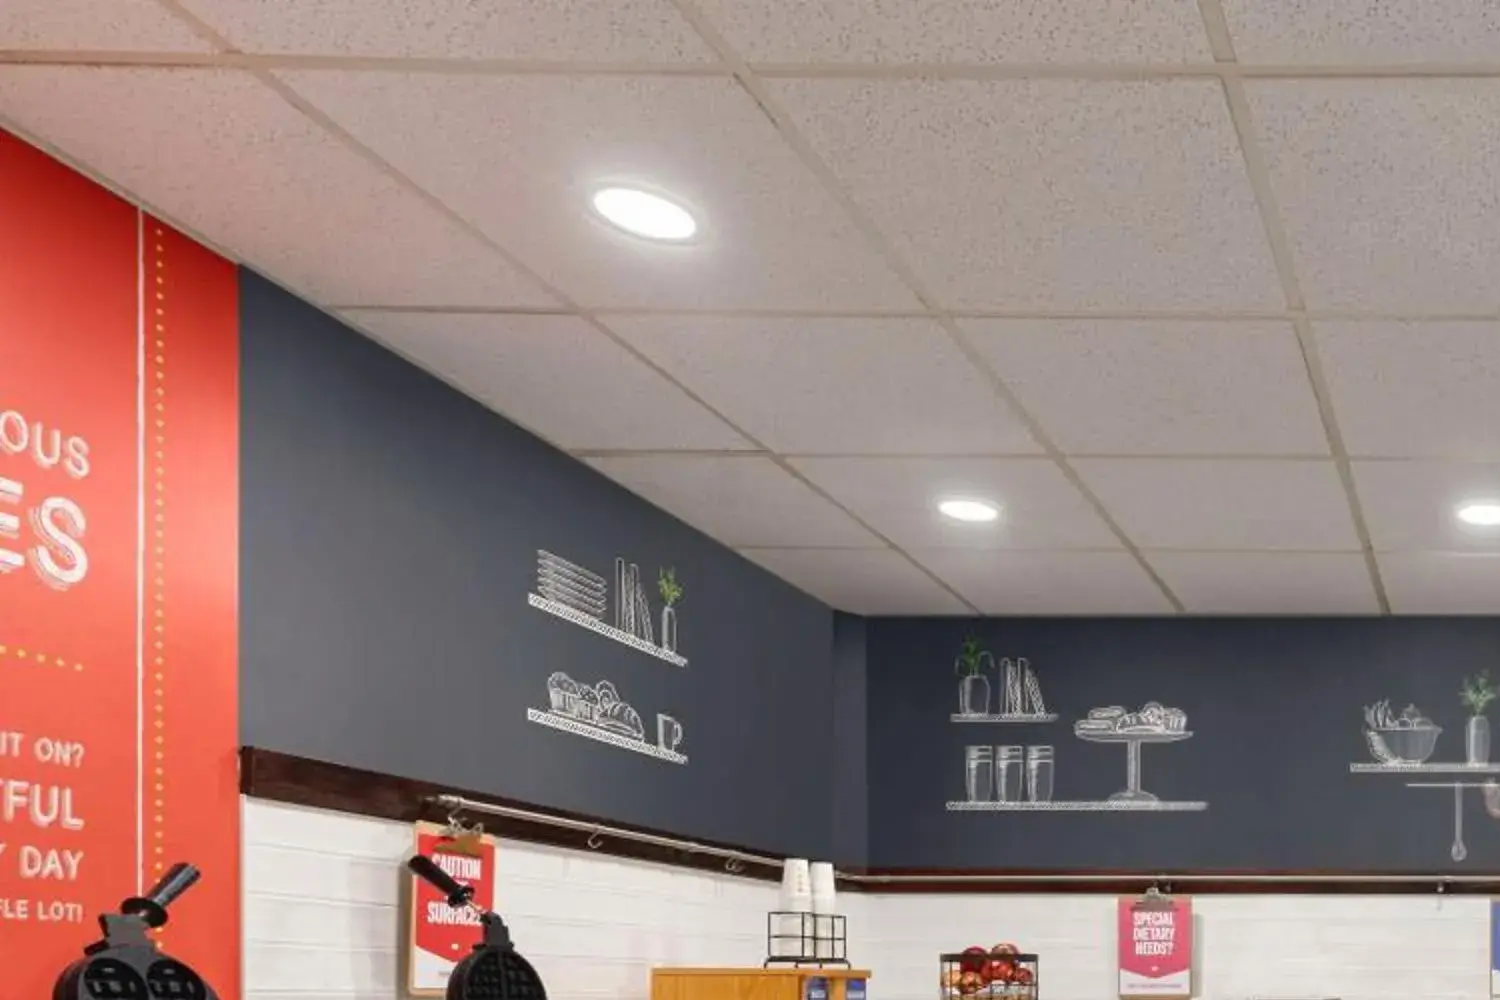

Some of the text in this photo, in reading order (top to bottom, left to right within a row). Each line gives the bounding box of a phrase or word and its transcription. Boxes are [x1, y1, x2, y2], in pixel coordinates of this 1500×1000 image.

[34, 737, 85, 768] ON?
[0, 778, 85, 831] FUL
[19, 844, 84, 880] DAY
[1133, 911, 1173, 925] SPECIAL
[1132, 926, 1176, 941] DIETARY
[1135, 941, 1174, 955] NEEDS?
